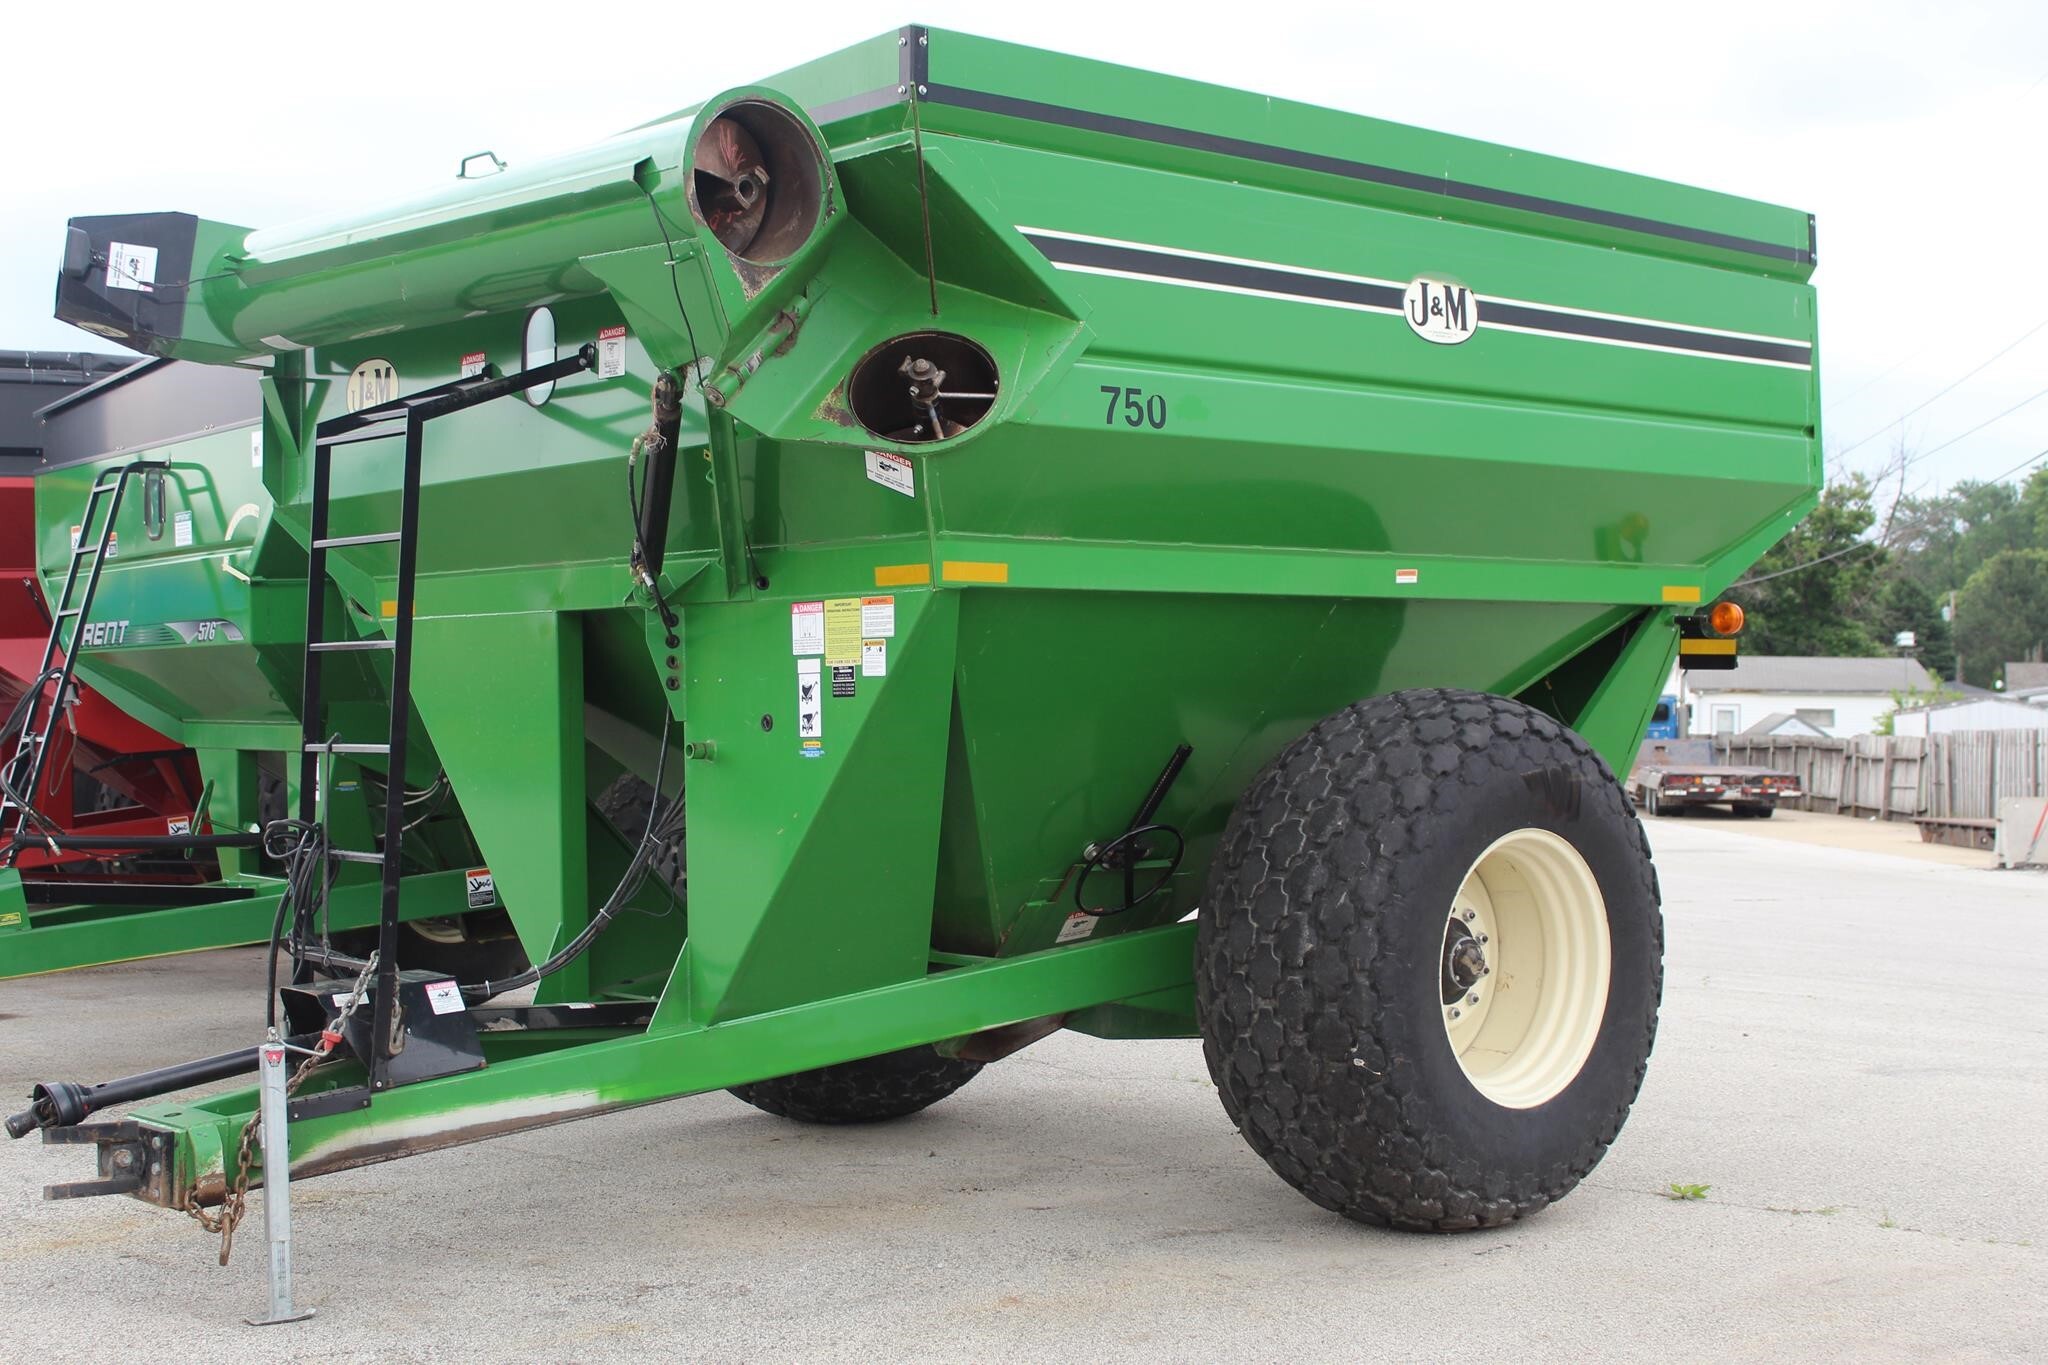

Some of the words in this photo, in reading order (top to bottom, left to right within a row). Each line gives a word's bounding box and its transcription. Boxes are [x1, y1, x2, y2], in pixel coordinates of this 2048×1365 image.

[1410, 282, 1469, 331] J&M
[605, 327, 625, 338] DANGER
[466, 353, 486, 364] DANGER
[351, 366, 392, 409] J&M
[1100, 385, 1167, 429] 750
[800, 602, 823, 613] DANGER
[81, 620, 129, 646] RENT
[198, 621, 216, 640] 576
